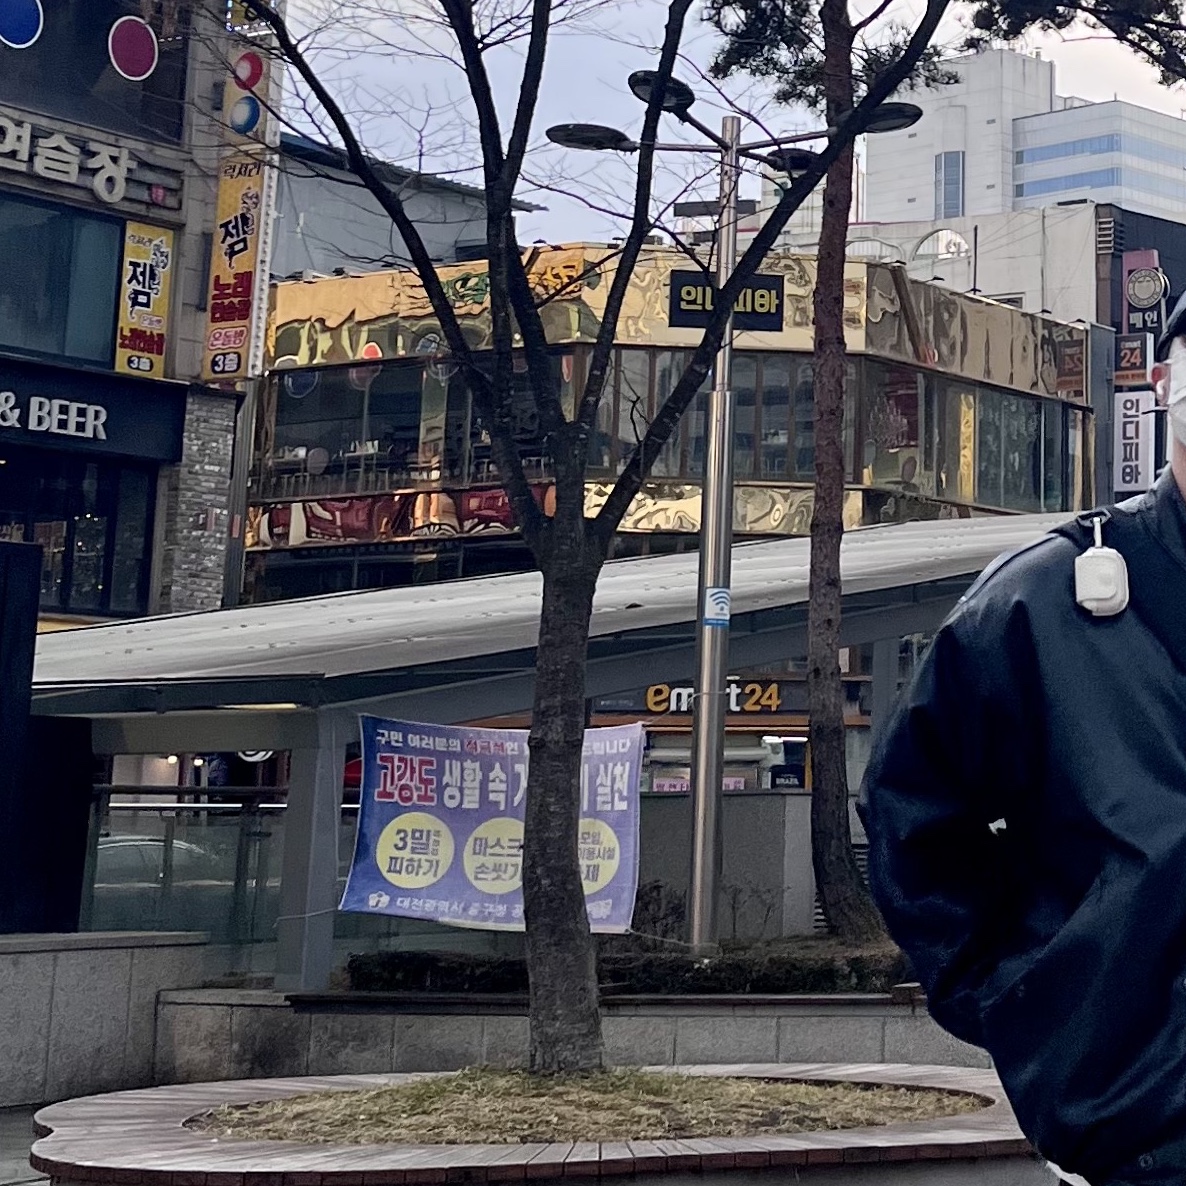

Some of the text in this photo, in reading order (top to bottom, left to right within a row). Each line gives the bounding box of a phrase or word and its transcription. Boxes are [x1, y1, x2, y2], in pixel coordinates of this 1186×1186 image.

[213, 353, 238, 372] 3층
[1120, 348, 1142, 367] 24
[0, 391, 108, 440] & BEER
[646, 683, 781, 712] emt24
[376, 729, 403, 747] 구민
[375, 753, 438, 806] 고강도
[442, 758, 483, 809] 생활
[488, 762, 507, 811] 속
[596, 761, 630, 811] 실천
[386, 856, 440, 878] 피하기
